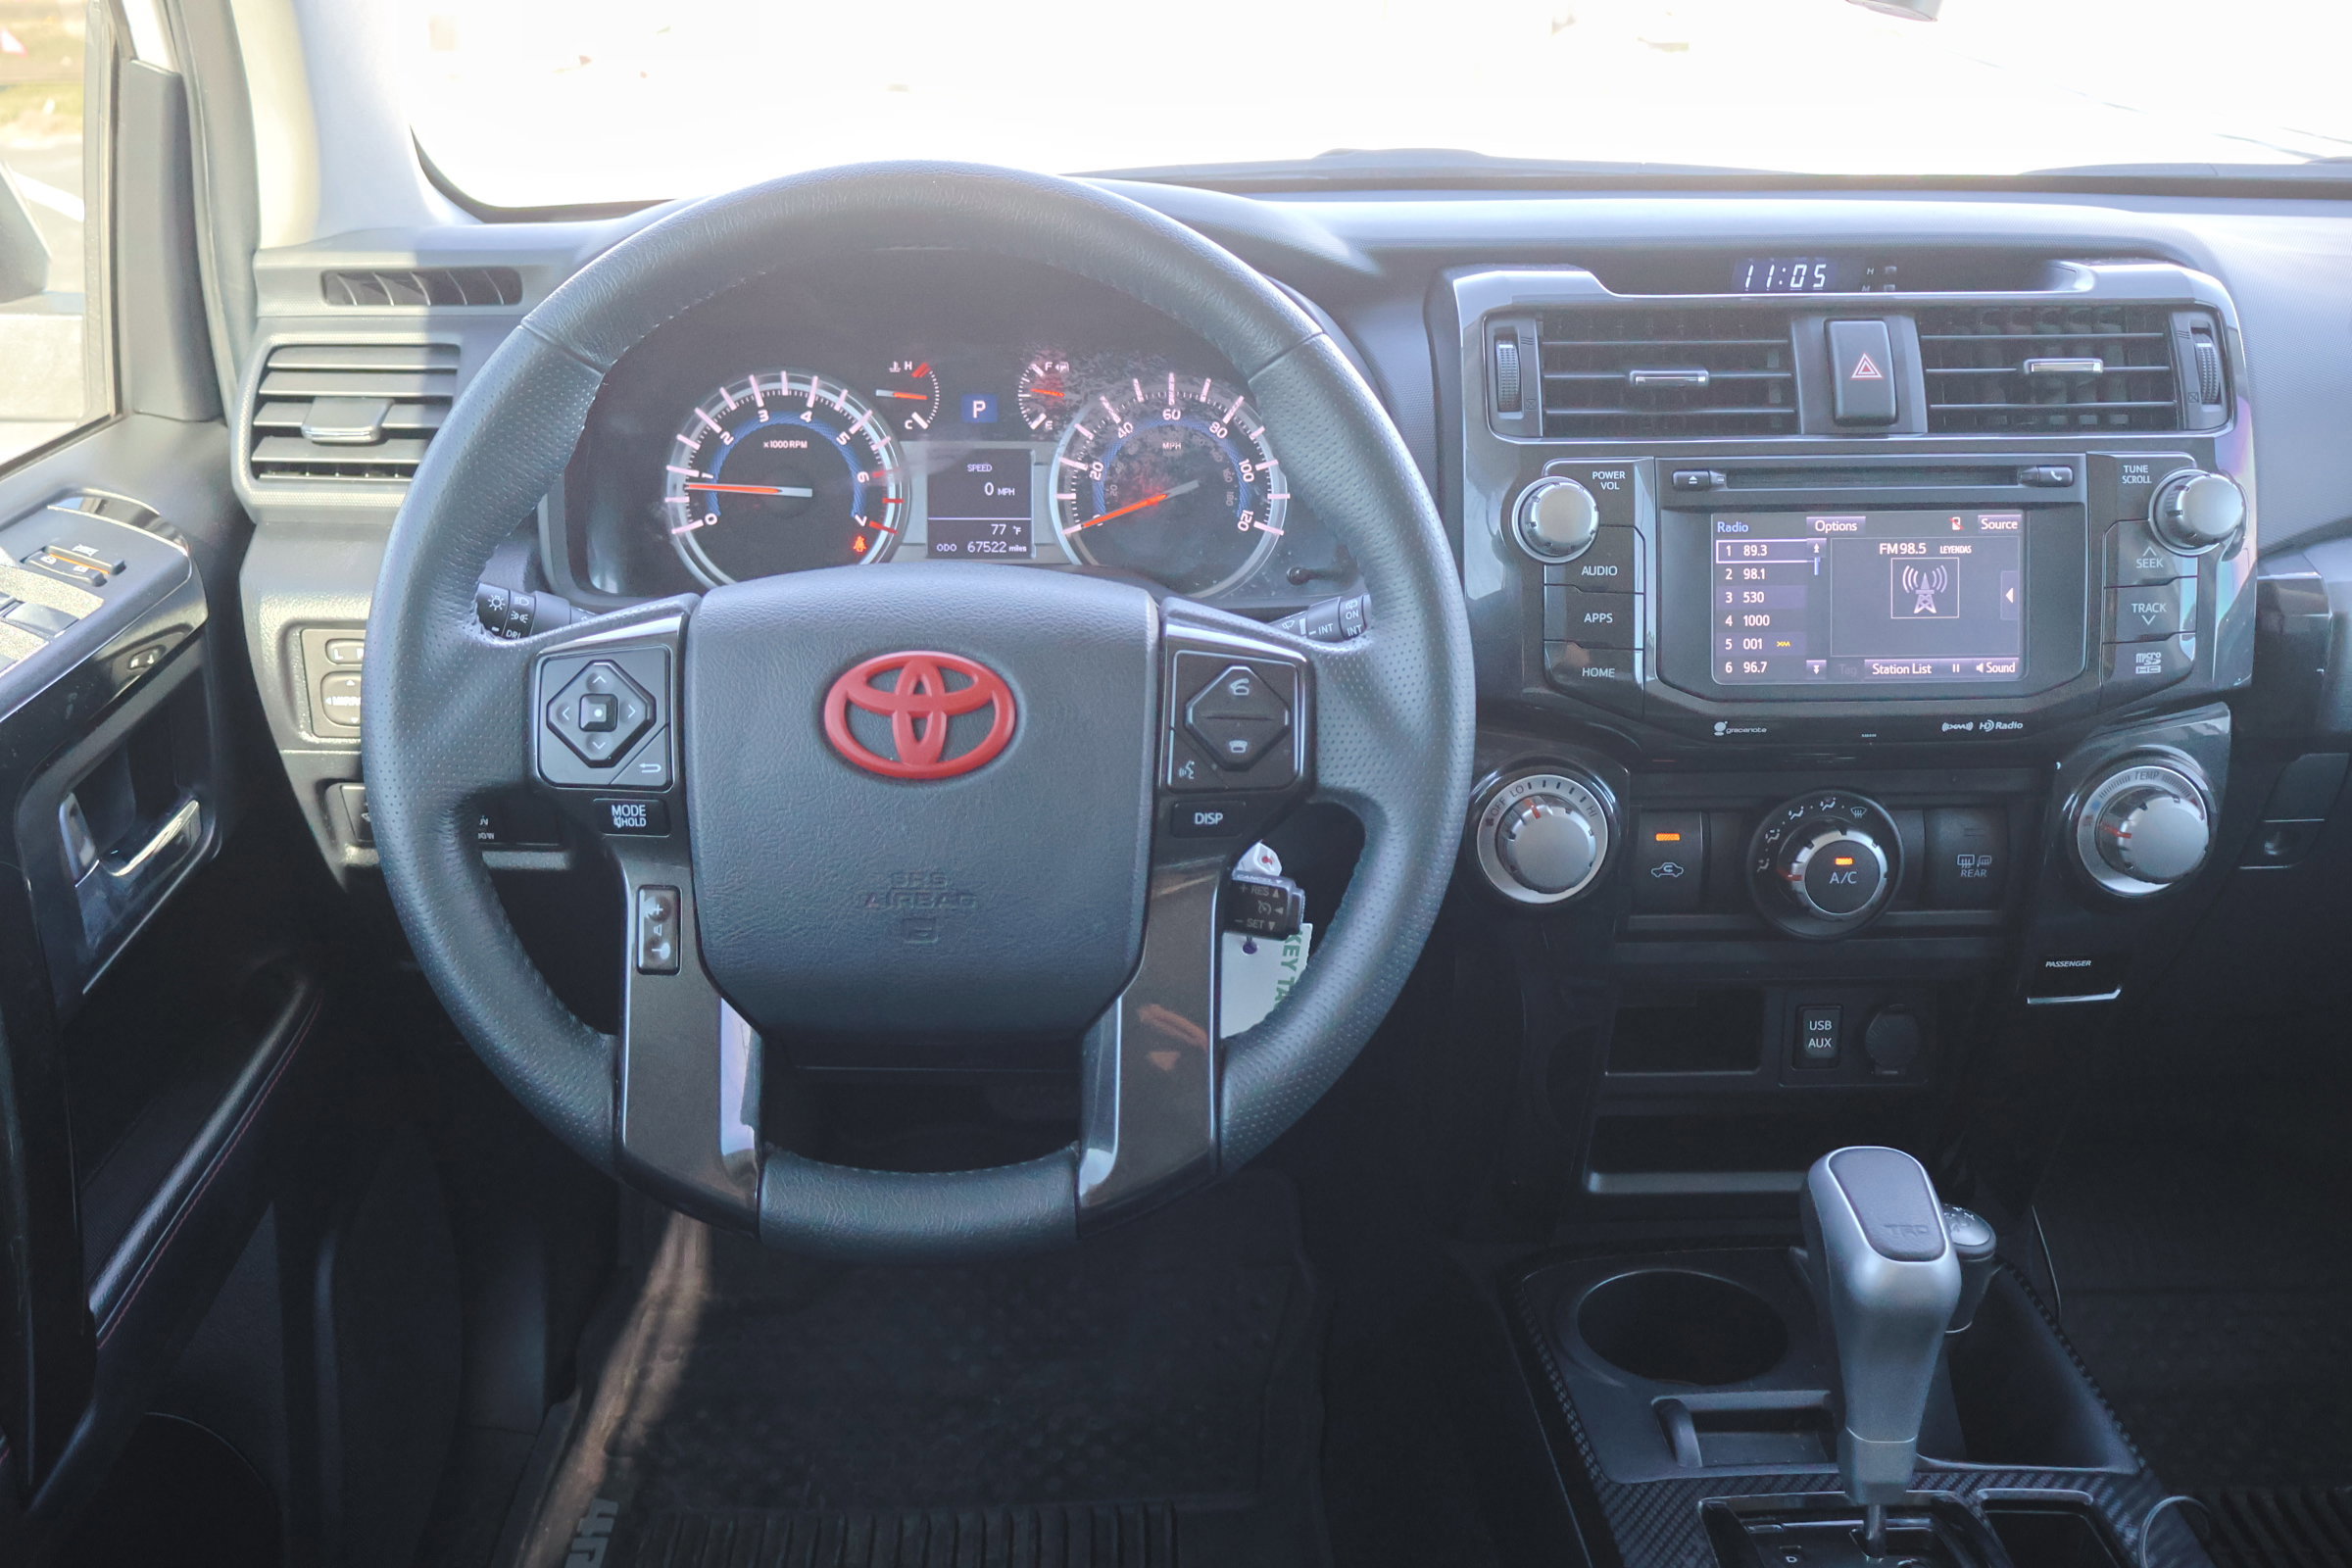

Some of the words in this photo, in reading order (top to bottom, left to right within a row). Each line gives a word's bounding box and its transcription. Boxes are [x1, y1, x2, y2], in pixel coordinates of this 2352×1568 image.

[1744, 264, 1827, 289] 11:05
[904, 361, 912, 370] H
[1045, 362, 1054, 370] F
[972, 400, 986, 417] P
[758, 410, 769, 422] 3
[800, 410, 813, 423] 4
[1162, 409, 1181, 421] 60
[905, 419, 913, 430] C
[1045, 419, 1054, 430] E
[1117, 421, 1134, 439] 40
[1209, 421, 1229, 439] 80
[720, 431, 735, 445] 2
[836, 432, 851, 446] 5
[967, 464, 993, 472] SPEED
[1089, 462, 1104, 480] 20
[1240, 462, 1255, 483] 100
[2123, 465, 2149, 473] TUNE
[857, 471, 869, 482] 6
[1592, 471, 1626, 480] POWER
[2122, 475, 2152, 484] SCROLL
[984, 482, 994, 496] 0
[1600, 481, 1620, 490] VOL
[705, 513, 718, 526] 0
[855, 514, 867, 527] 7
[1238, 510, 1254, 532] 120
[1981, 518, 2018, 530] Source
[991, 523, 1006, 535] 77
[1717, 521, 1748, 533] Radio
[1814, 520, 1858, 533] Options
[936, 543, 956, 552] ODO
[967, 541, 1007, 553] 67522
[1726, 545, 1732, 557] 1
[1743, 545, 1768, 557] 89.3
[2135, 558, 2164, 568] SEEK
[1581, 565, 1618, 576] AUDIO
[1725, 568, 1733, 580] 2
[1743, 568, 1766, 580] 98.1
[1725, 592, 1733, 603] 3
[1742, 592, 1765, 603] 530
[2132, 603, 2167, 613] TRACK
[1346, 610, 1359, 619] ON
[1584, 612, 1613, 623] APPS
[1725, 615, 1733, 626] 4
[1742, 615, 1770, 626] 1000
[1318, 623, 1334, 635] INT
[1347, 624, 1362, 636] INT
[1725, 639, 1733, 650] 5
[1742, 639, 1763, 650] 001
[334, 648, 343, 660] L
[1582, 667, 1615, 678] HOME
[1725, 662, 1733, 673] 6
[1743, 662, 1768, 673] 96.7
[1872, 663, 1908, 674] Station
[1912, 663, 1932, 674] List
[1985, 662, 2016, 673] Sound
[1995, 721, 2024, 730] Radio
[2133, 770, 2160, 781] TEMP
[1491, 797, 1506, 817] OFF
[1509, 785, 1525, 798] LO
[611, 805, 647, 816] MODE
[1586, 806, 1598, 818] HI
[621, 816, 647, 827] HOLD
[1195, 812, 1223, 825] DISP
[1829, 871, 1858, 884] A/C
[1961, 868, 1987, 878] REAR
[1250, 885, 1270, 897] RES
[1247, 917, 1265, 930] SET
[2045, 959, 2092, 968] PASSENGER
[1809, 1020, 1833, 1030] USB
[1807, 1037, 1832, 1048] AUX
